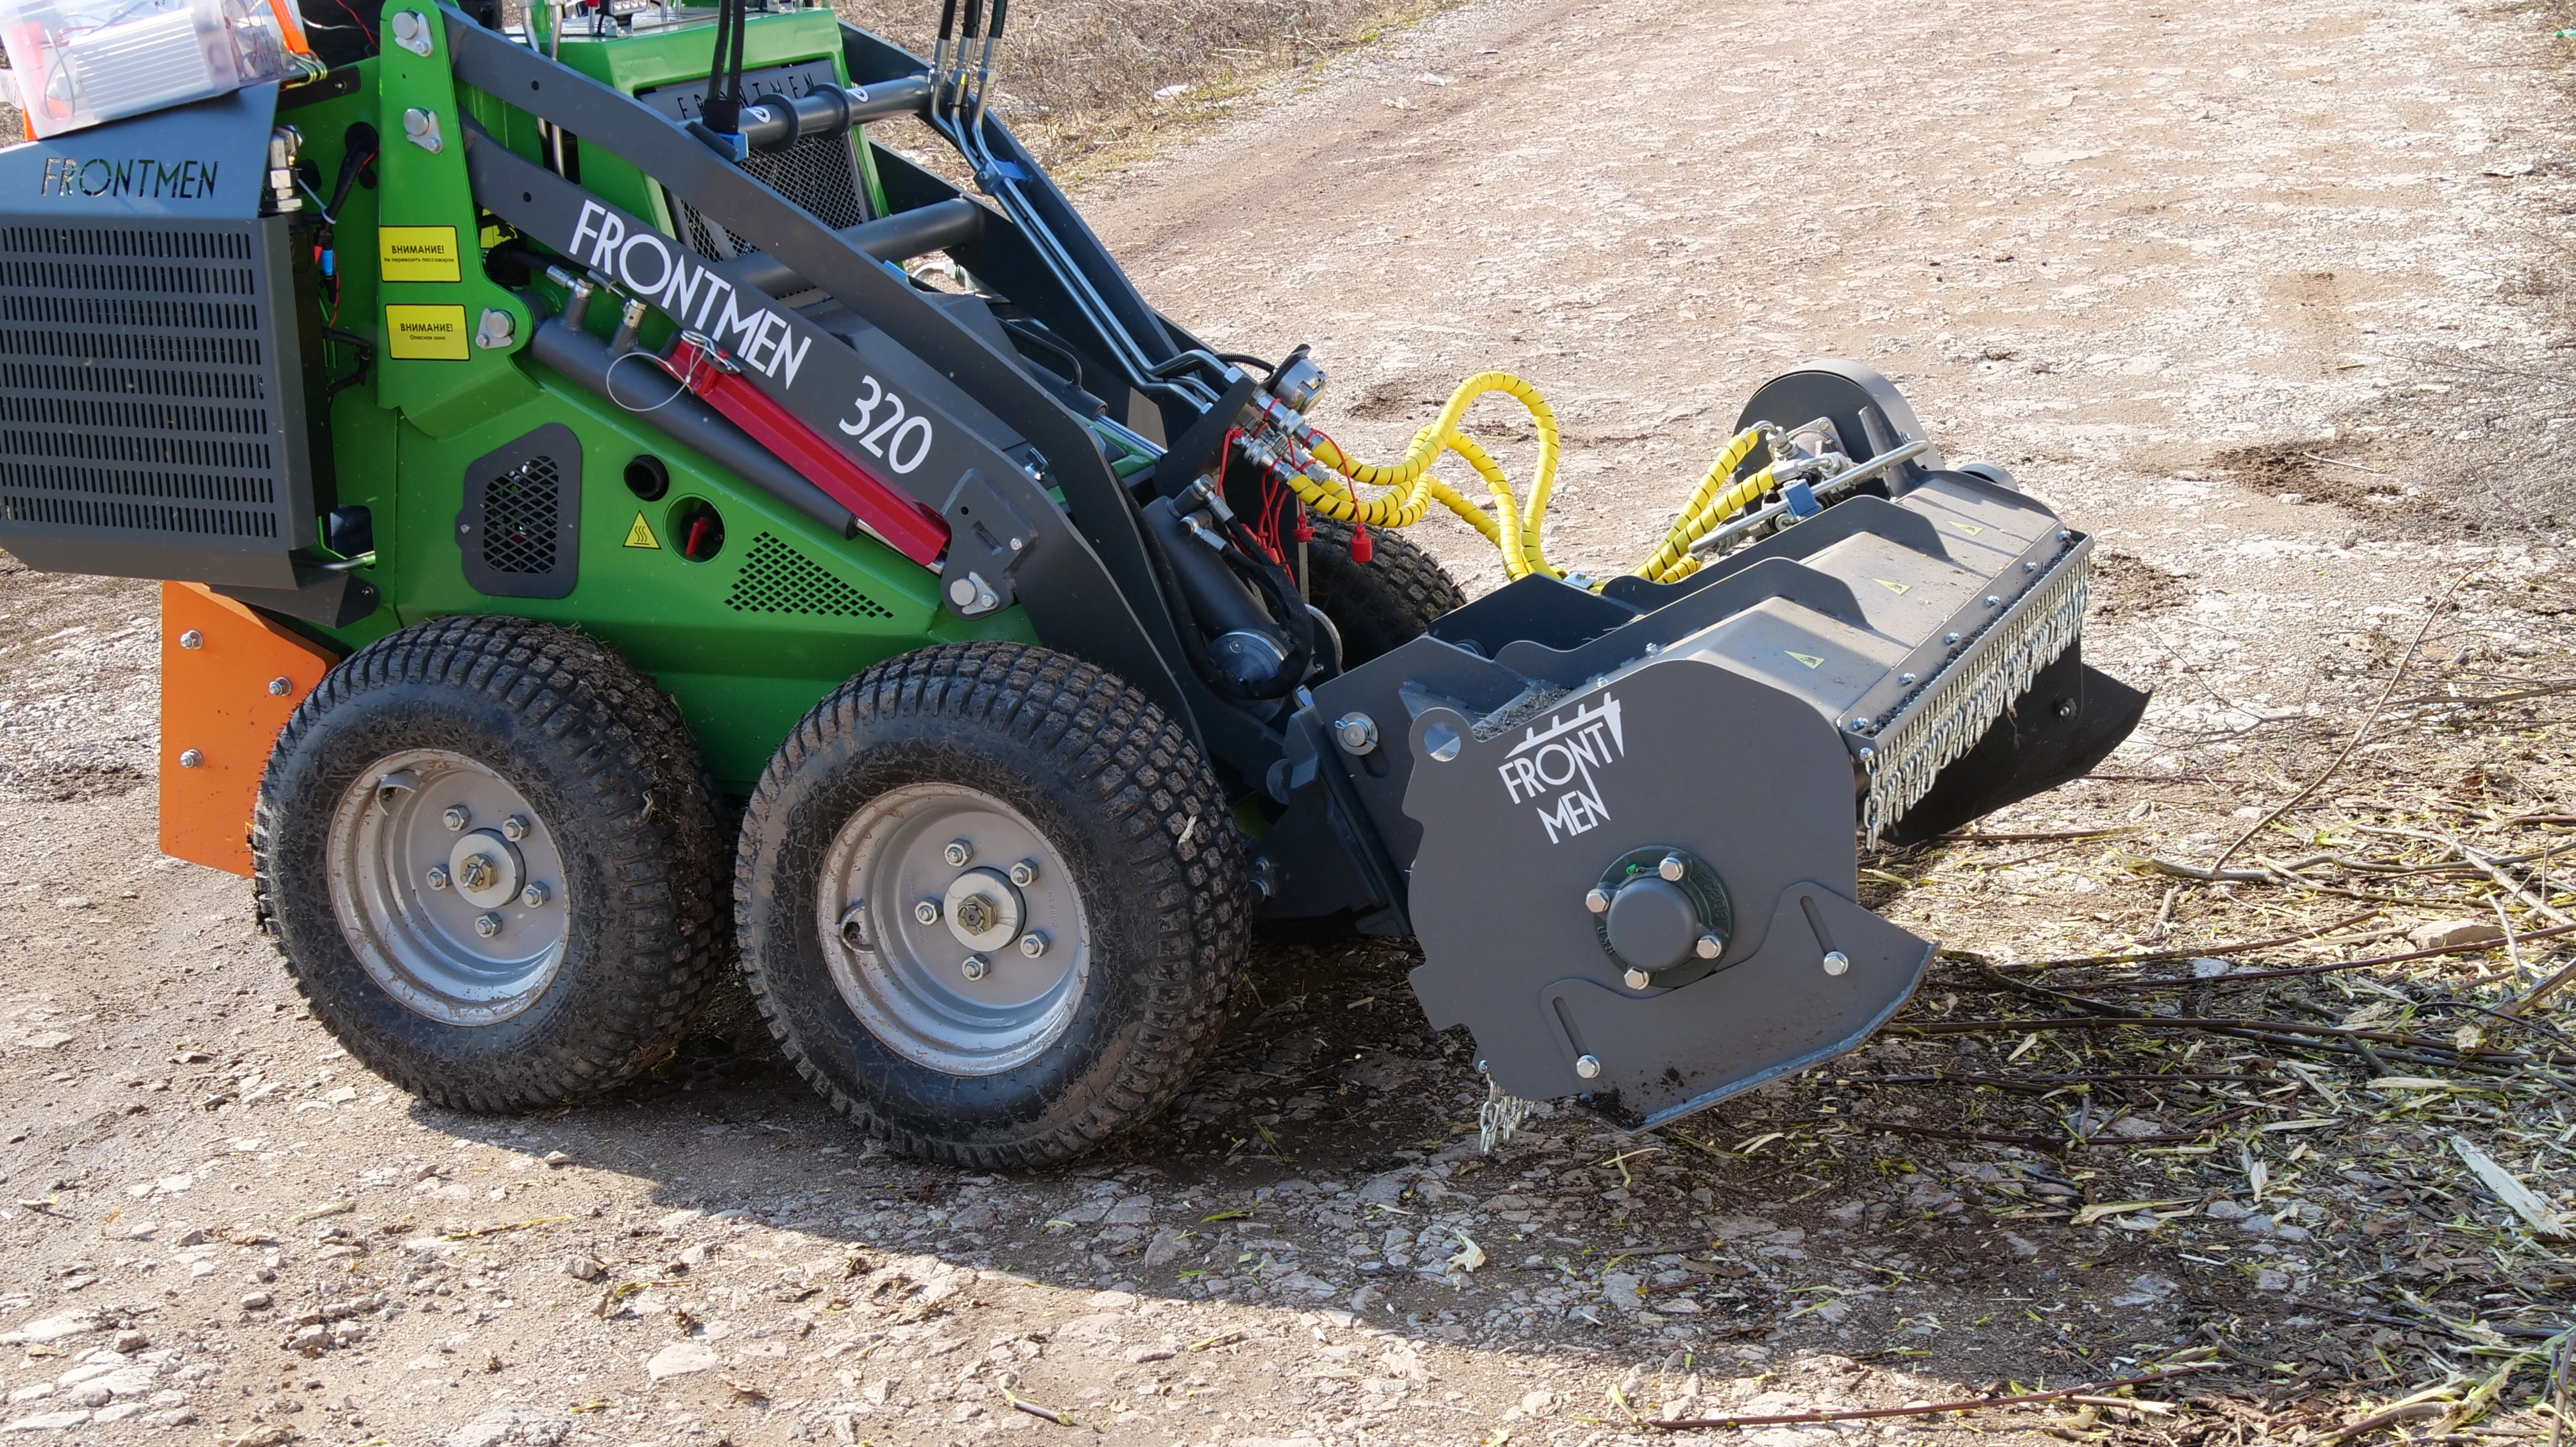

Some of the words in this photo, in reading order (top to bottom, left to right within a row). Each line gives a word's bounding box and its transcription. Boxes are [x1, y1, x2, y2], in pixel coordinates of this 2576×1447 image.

[677, 72, 814, 119] FRNTMEN
[41, 158, 218, 199] FRONTMEN
[391, 245, 445, 254] ВНИМАНИЕ!
[400, 323, 453, 332] ВНИМАНИЕ!
[569, 199, 812, 390] FRONTMEN
[839, 375, 932, 474] 320
[1498, 722, 1613, 804] FRONT
[1536, 790, 1611, 844] MEN
